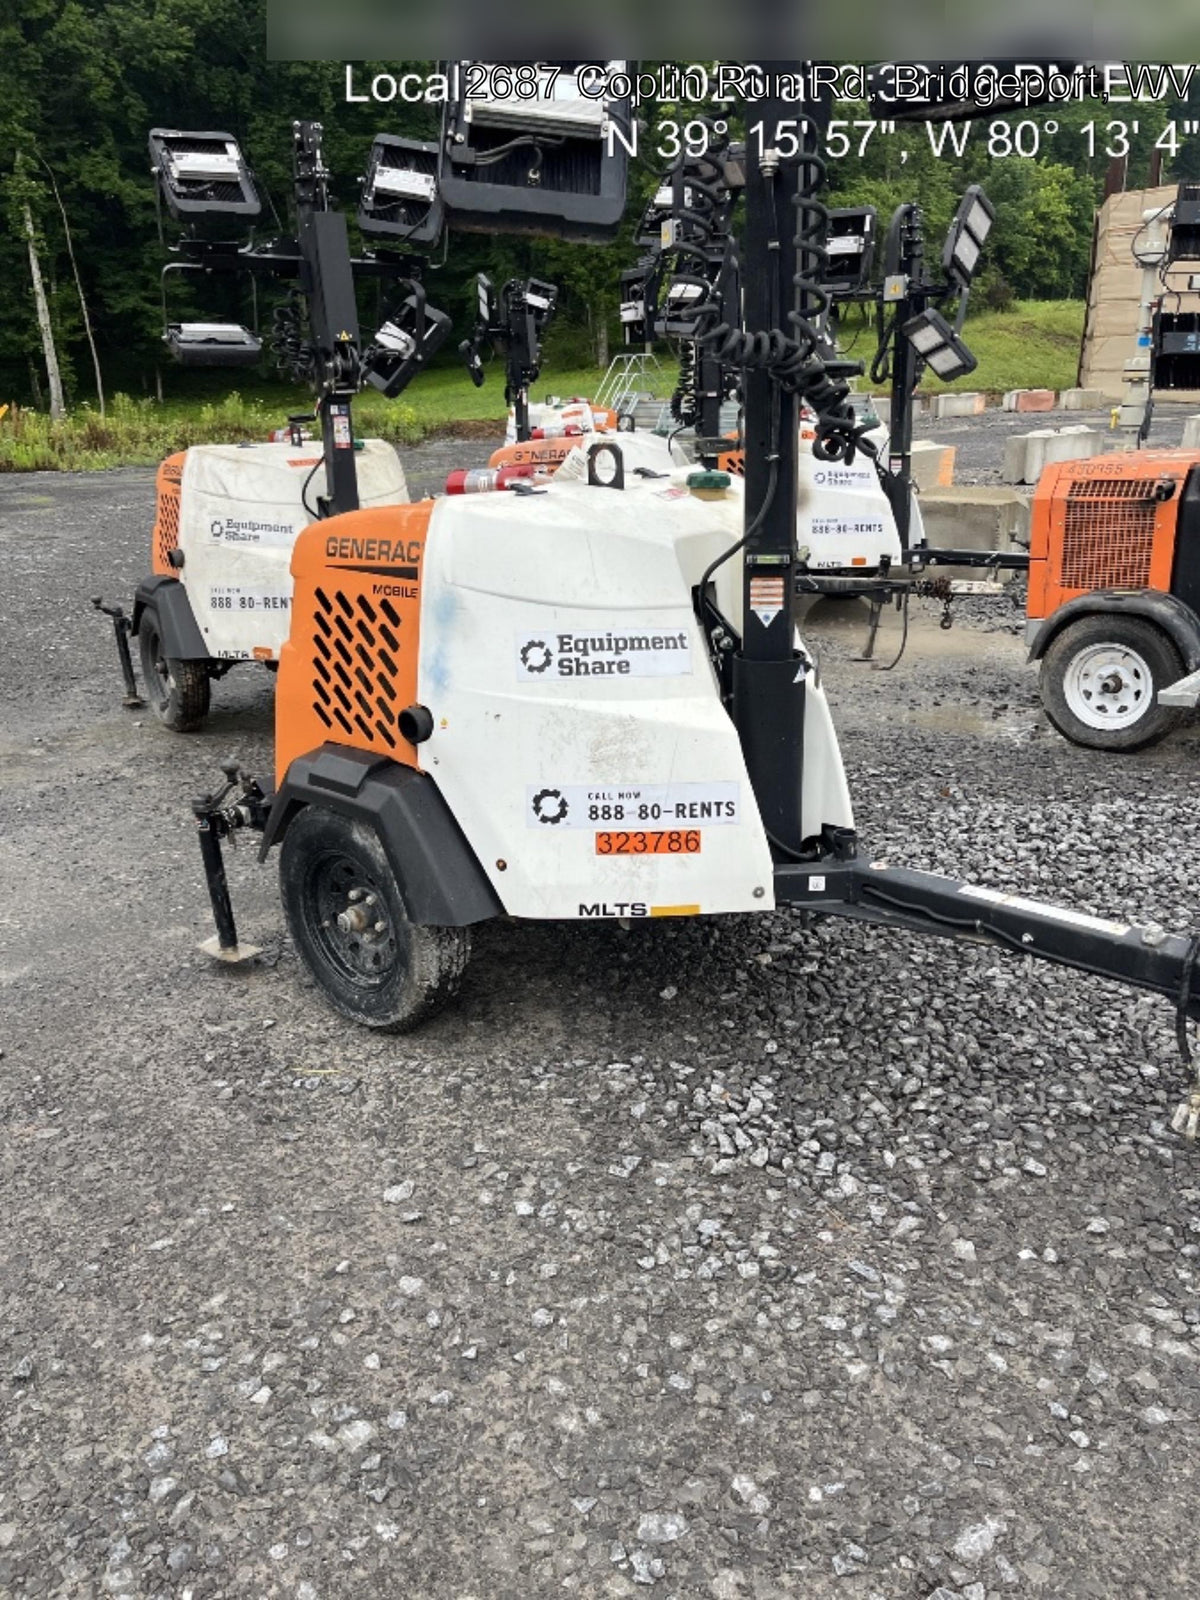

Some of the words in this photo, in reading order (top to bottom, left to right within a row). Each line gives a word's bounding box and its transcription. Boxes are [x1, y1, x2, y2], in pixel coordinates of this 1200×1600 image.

[326, 536, 420, 563] GENERAC
[372, 584, 418, 598] MOBILE
[557, 631, 688, 656] Equipment
[557, 656, 630, 677] Share
[618, 791, 641, 800] NOW
[598, 830, 700, 854] 323786
[579, 903, 648, 917] MLTS
